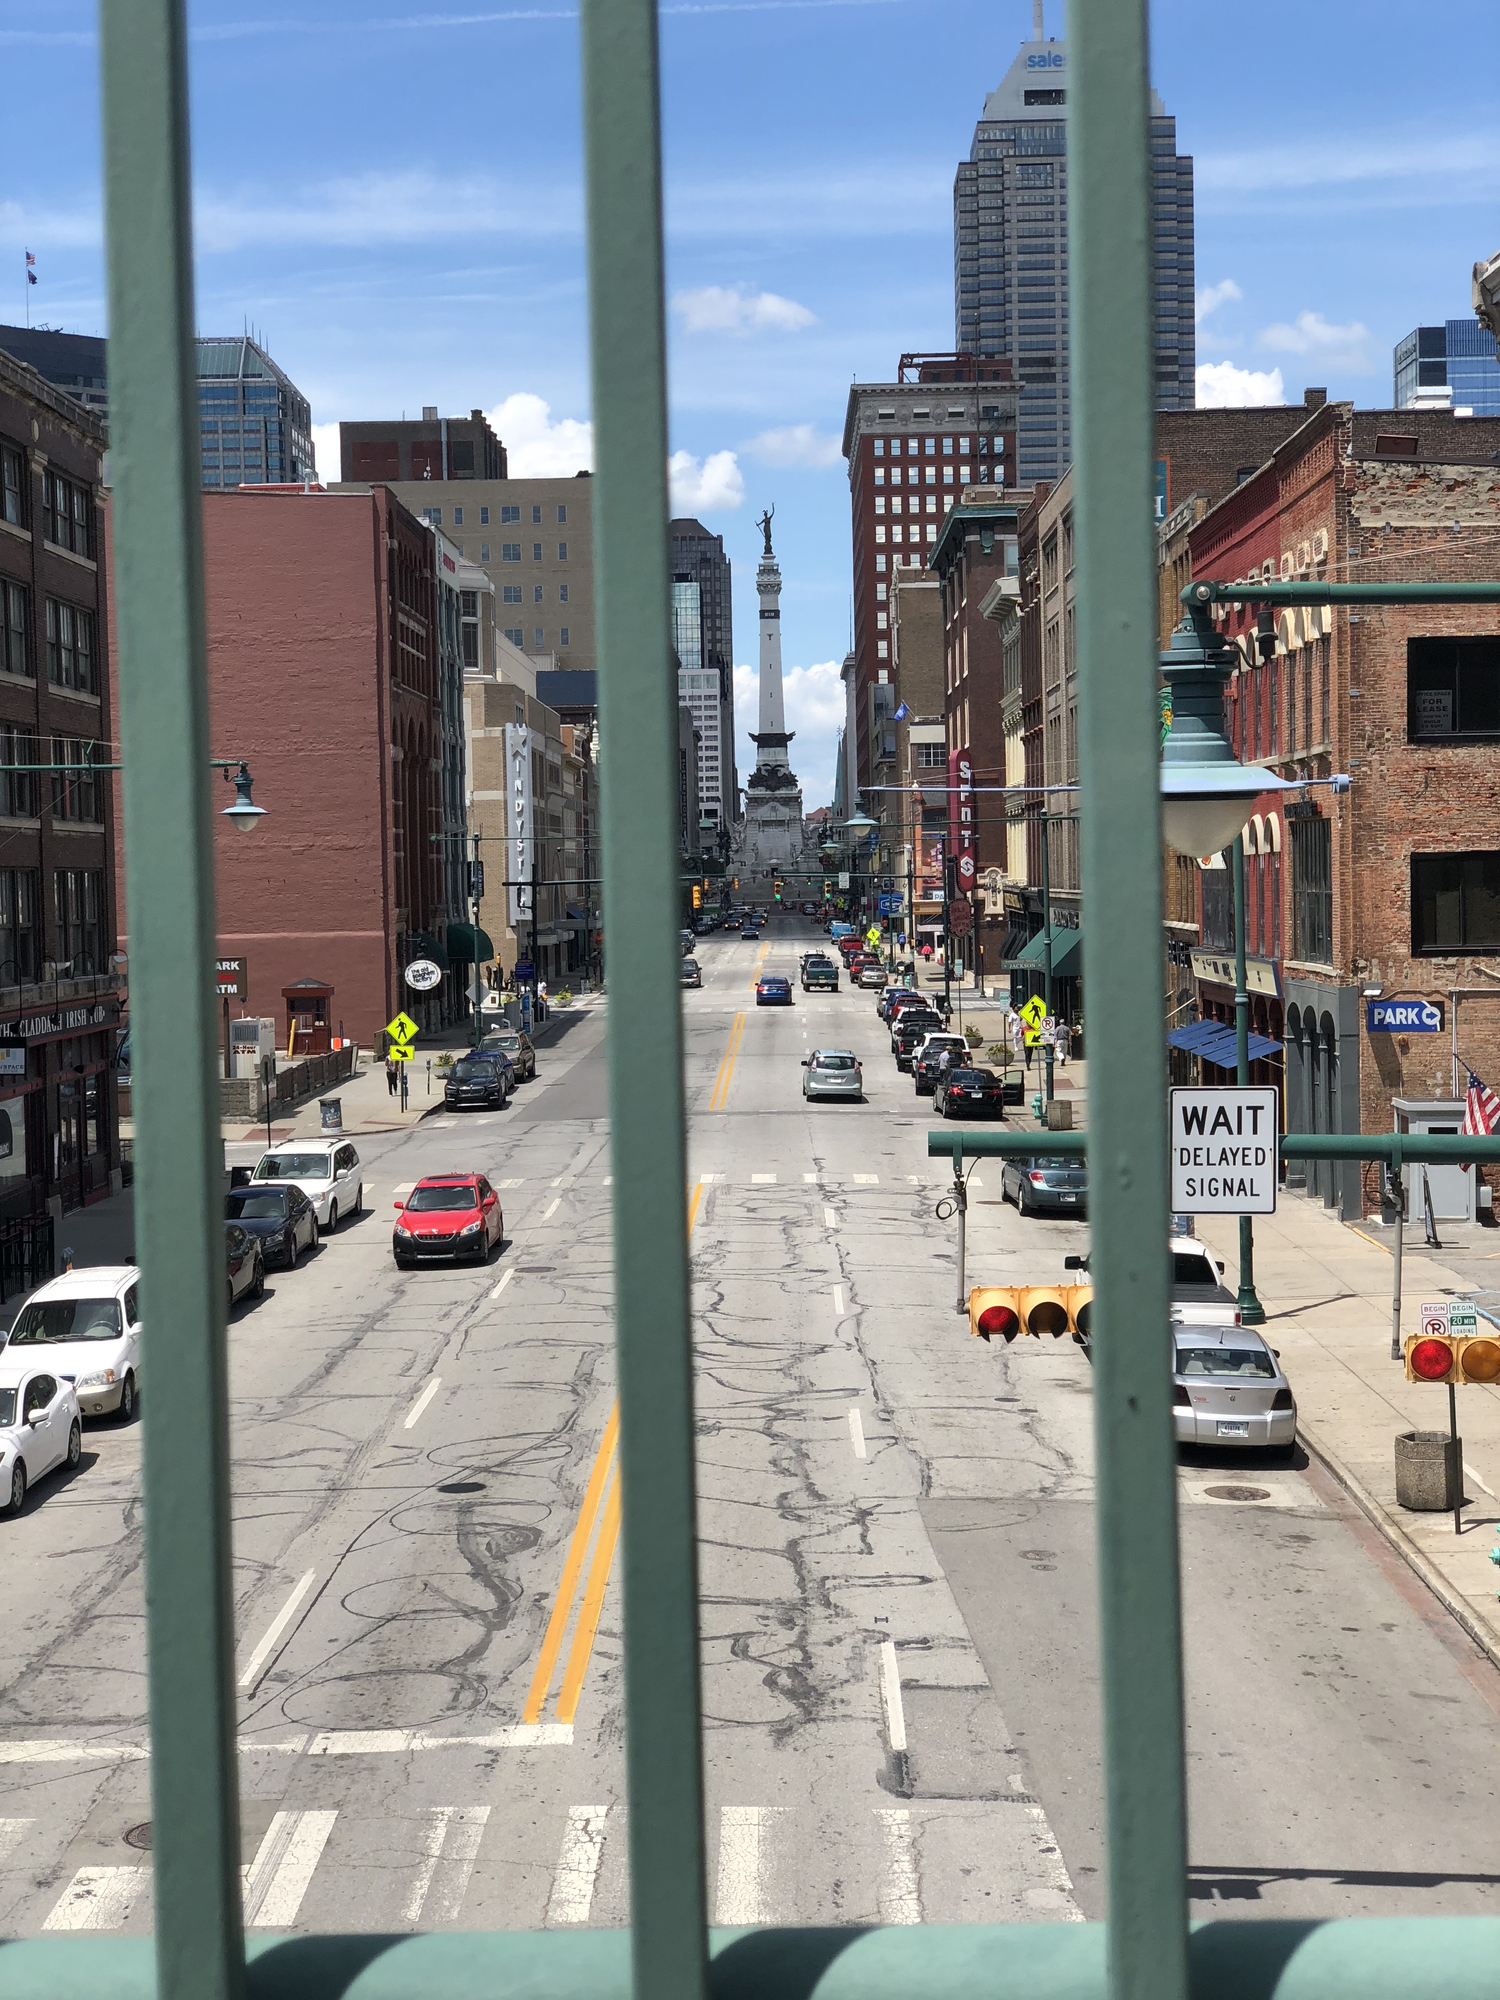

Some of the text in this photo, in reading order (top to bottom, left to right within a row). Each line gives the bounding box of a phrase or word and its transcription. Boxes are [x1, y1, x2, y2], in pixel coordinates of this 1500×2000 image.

[1027, 50, 1066, 68] sale
[215, 961, 240, 970] ARK
[66, 1008, 87, 1029] IRISH
[1373, 1007, 1420, 1025] PARK
[1181, 1105, 1265, 1136] WAIT
[1179, 1147, 1266, 1167] DELAYED
[1185, 1177, 1261, 1198] SIGNAL
[1451, 1316, 1463, 1325] 20
